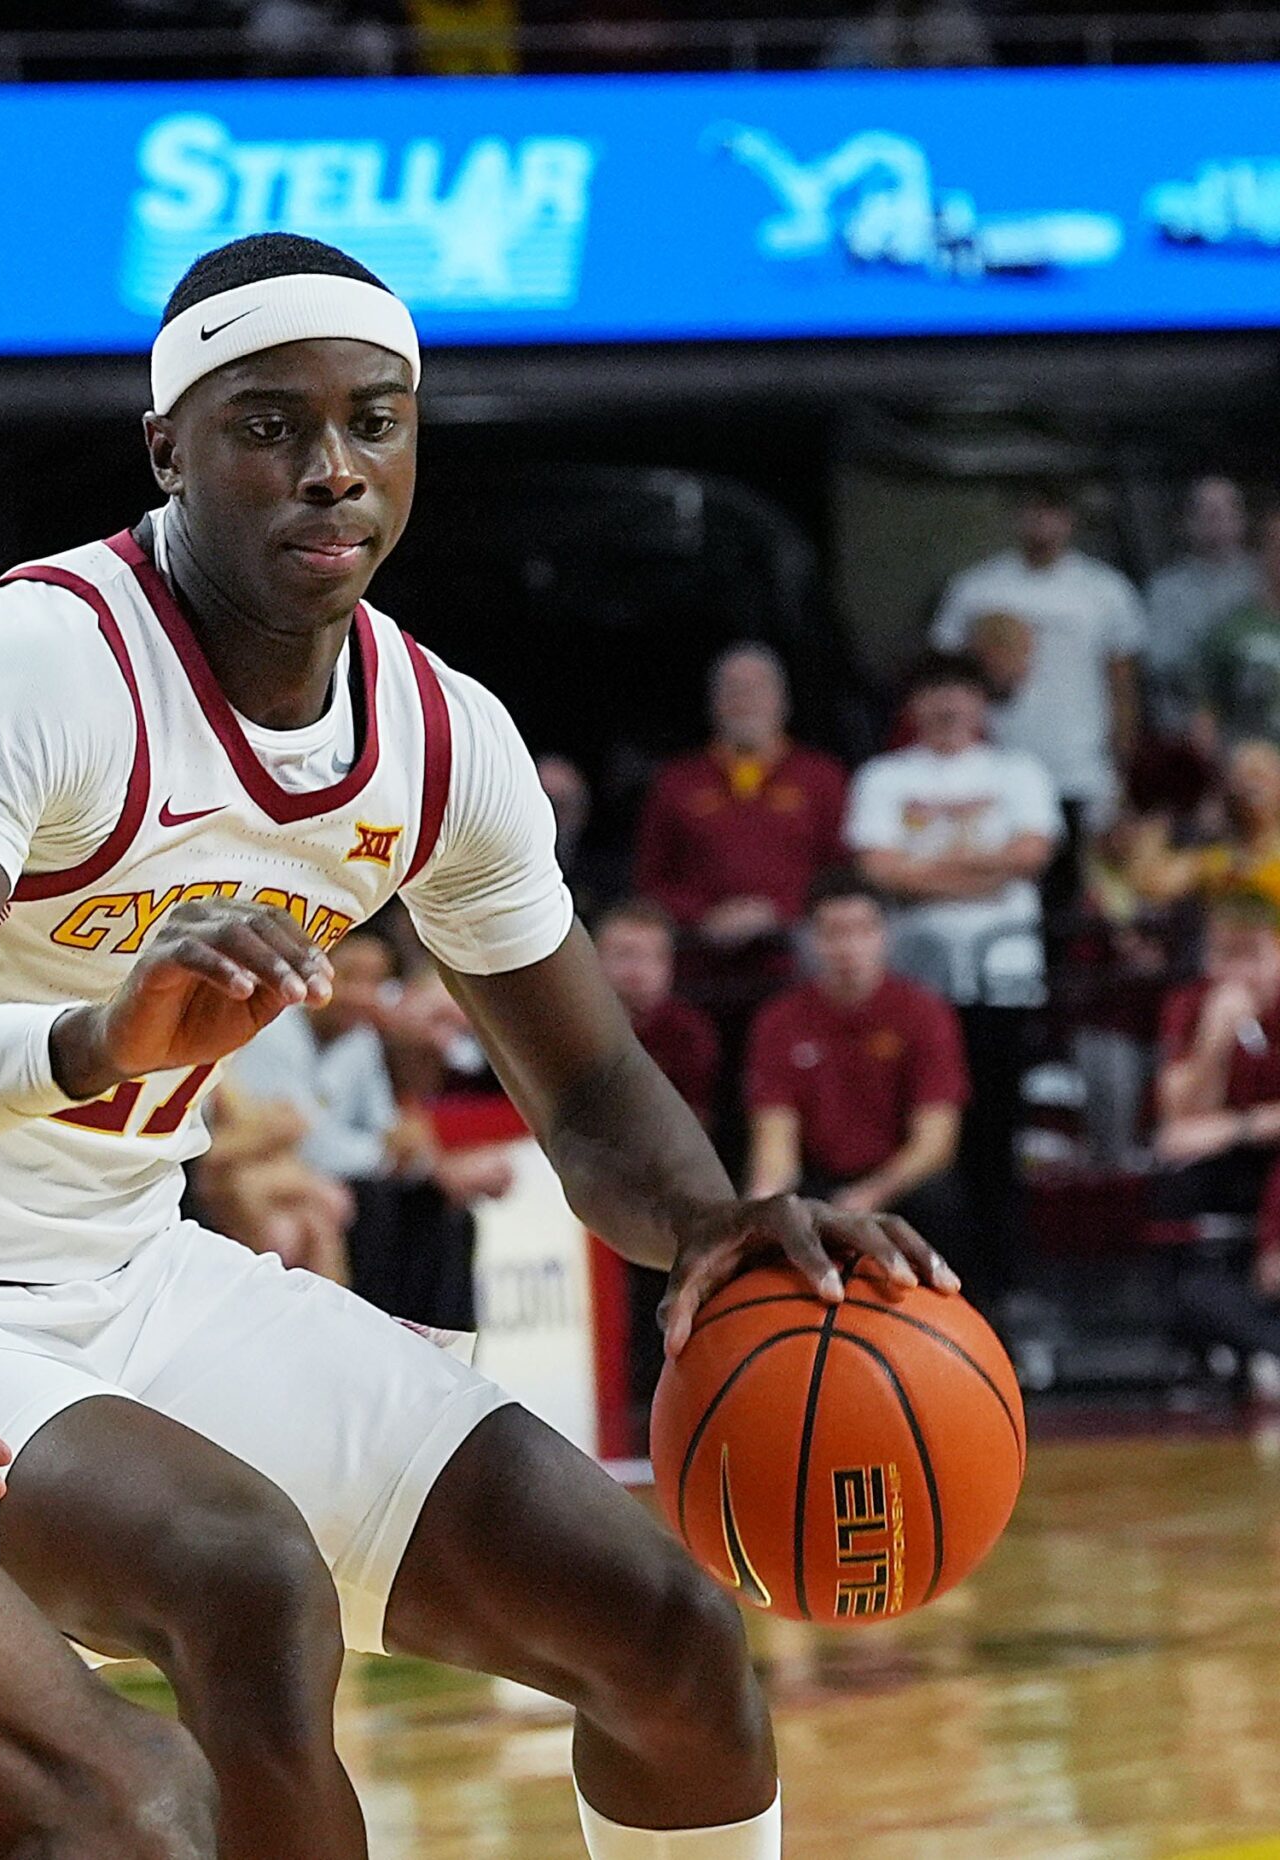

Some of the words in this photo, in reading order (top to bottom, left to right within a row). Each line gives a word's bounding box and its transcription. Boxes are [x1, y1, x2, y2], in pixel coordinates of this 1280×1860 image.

[135, 112, 594, 230] STELLAR
[343, 821, 404, 869] XII
[50, 881, 354, 954] CYNE
